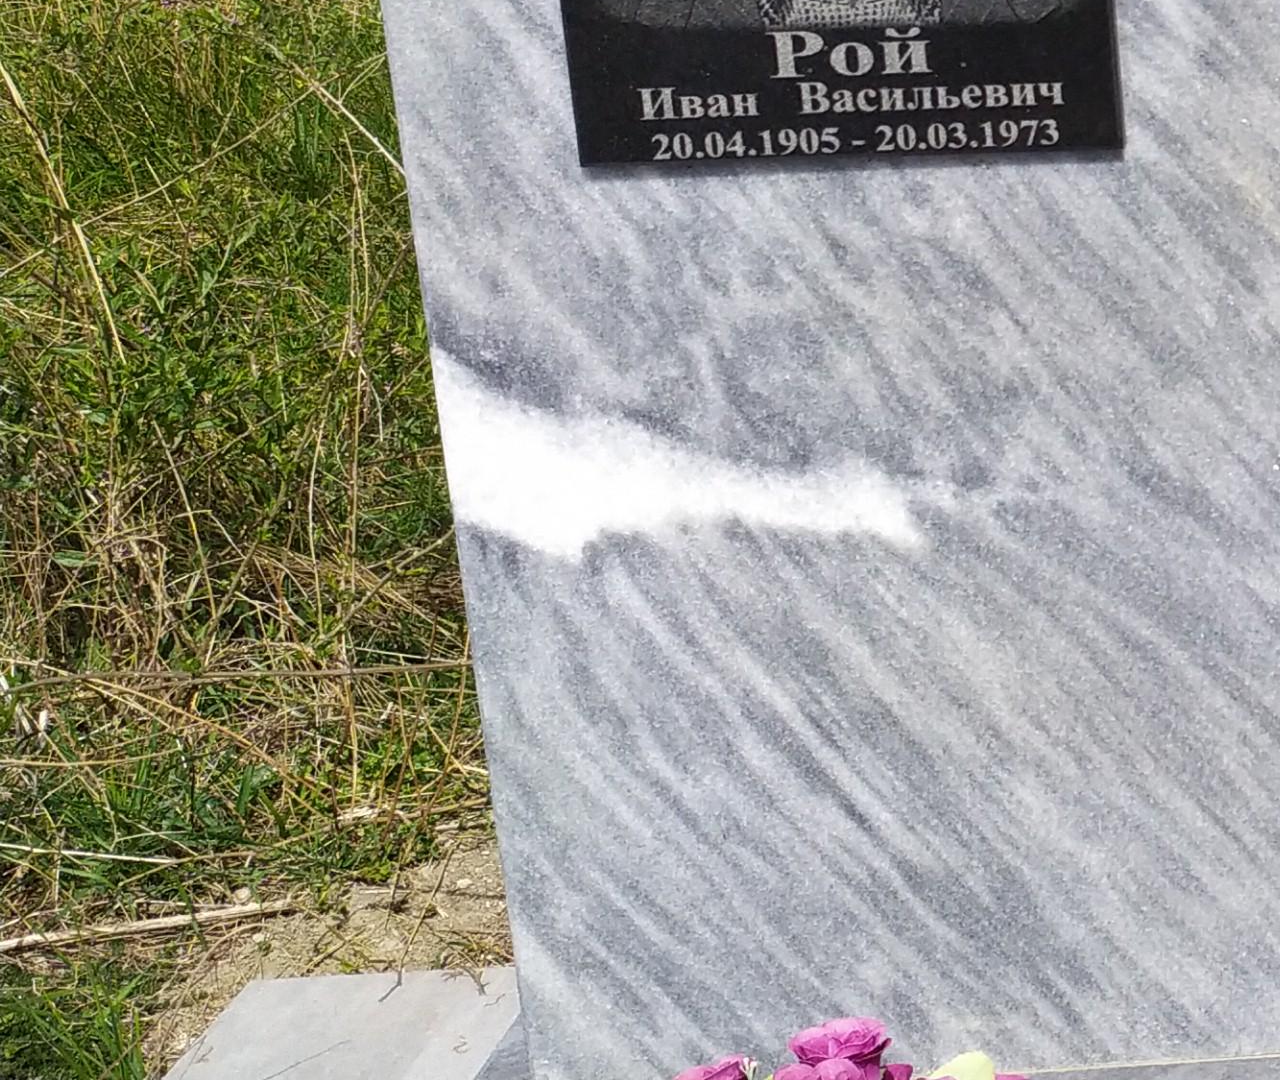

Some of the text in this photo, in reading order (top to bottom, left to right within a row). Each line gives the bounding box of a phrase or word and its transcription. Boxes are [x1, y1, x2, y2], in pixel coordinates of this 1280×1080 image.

[765, 25, 933, 79] Рой
[636, 80, 1066, 122] Иван Васильевич
[650, 127, 842, 162] 20.04.1905
[874, 118, 1061, 153] 20.03.1973
